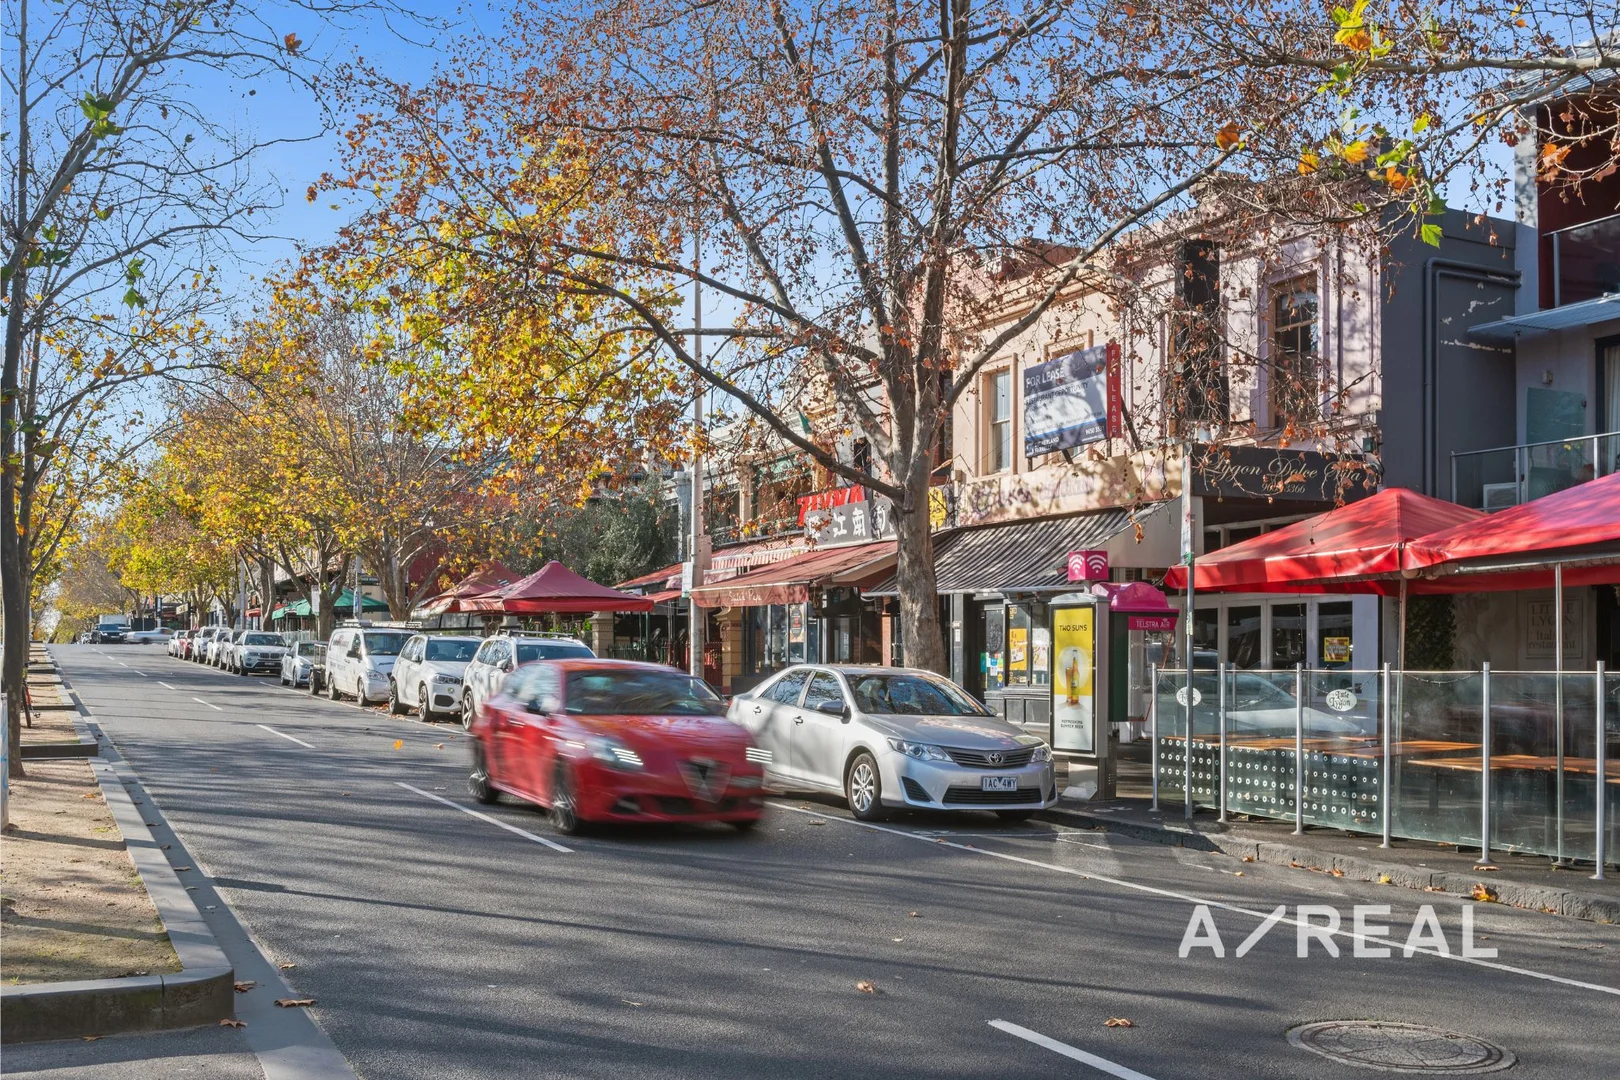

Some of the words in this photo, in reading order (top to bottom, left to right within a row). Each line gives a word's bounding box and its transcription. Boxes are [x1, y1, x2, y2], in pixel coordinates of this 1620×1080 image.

[1025, 375, 1041, 388] FOR
[1042, 367, 1064, 383] LEASE
[1205, 452, 1263, 482] Lygon
[1267, 456, 1318, 478] Dolce
[1071, 624, 1088, 632] SUNS
[1136, 620, 1159, 628] TELSTRA
[1160, 620, 1170, 628] AIR
[1328, 696, 1350, 709] Lygon
